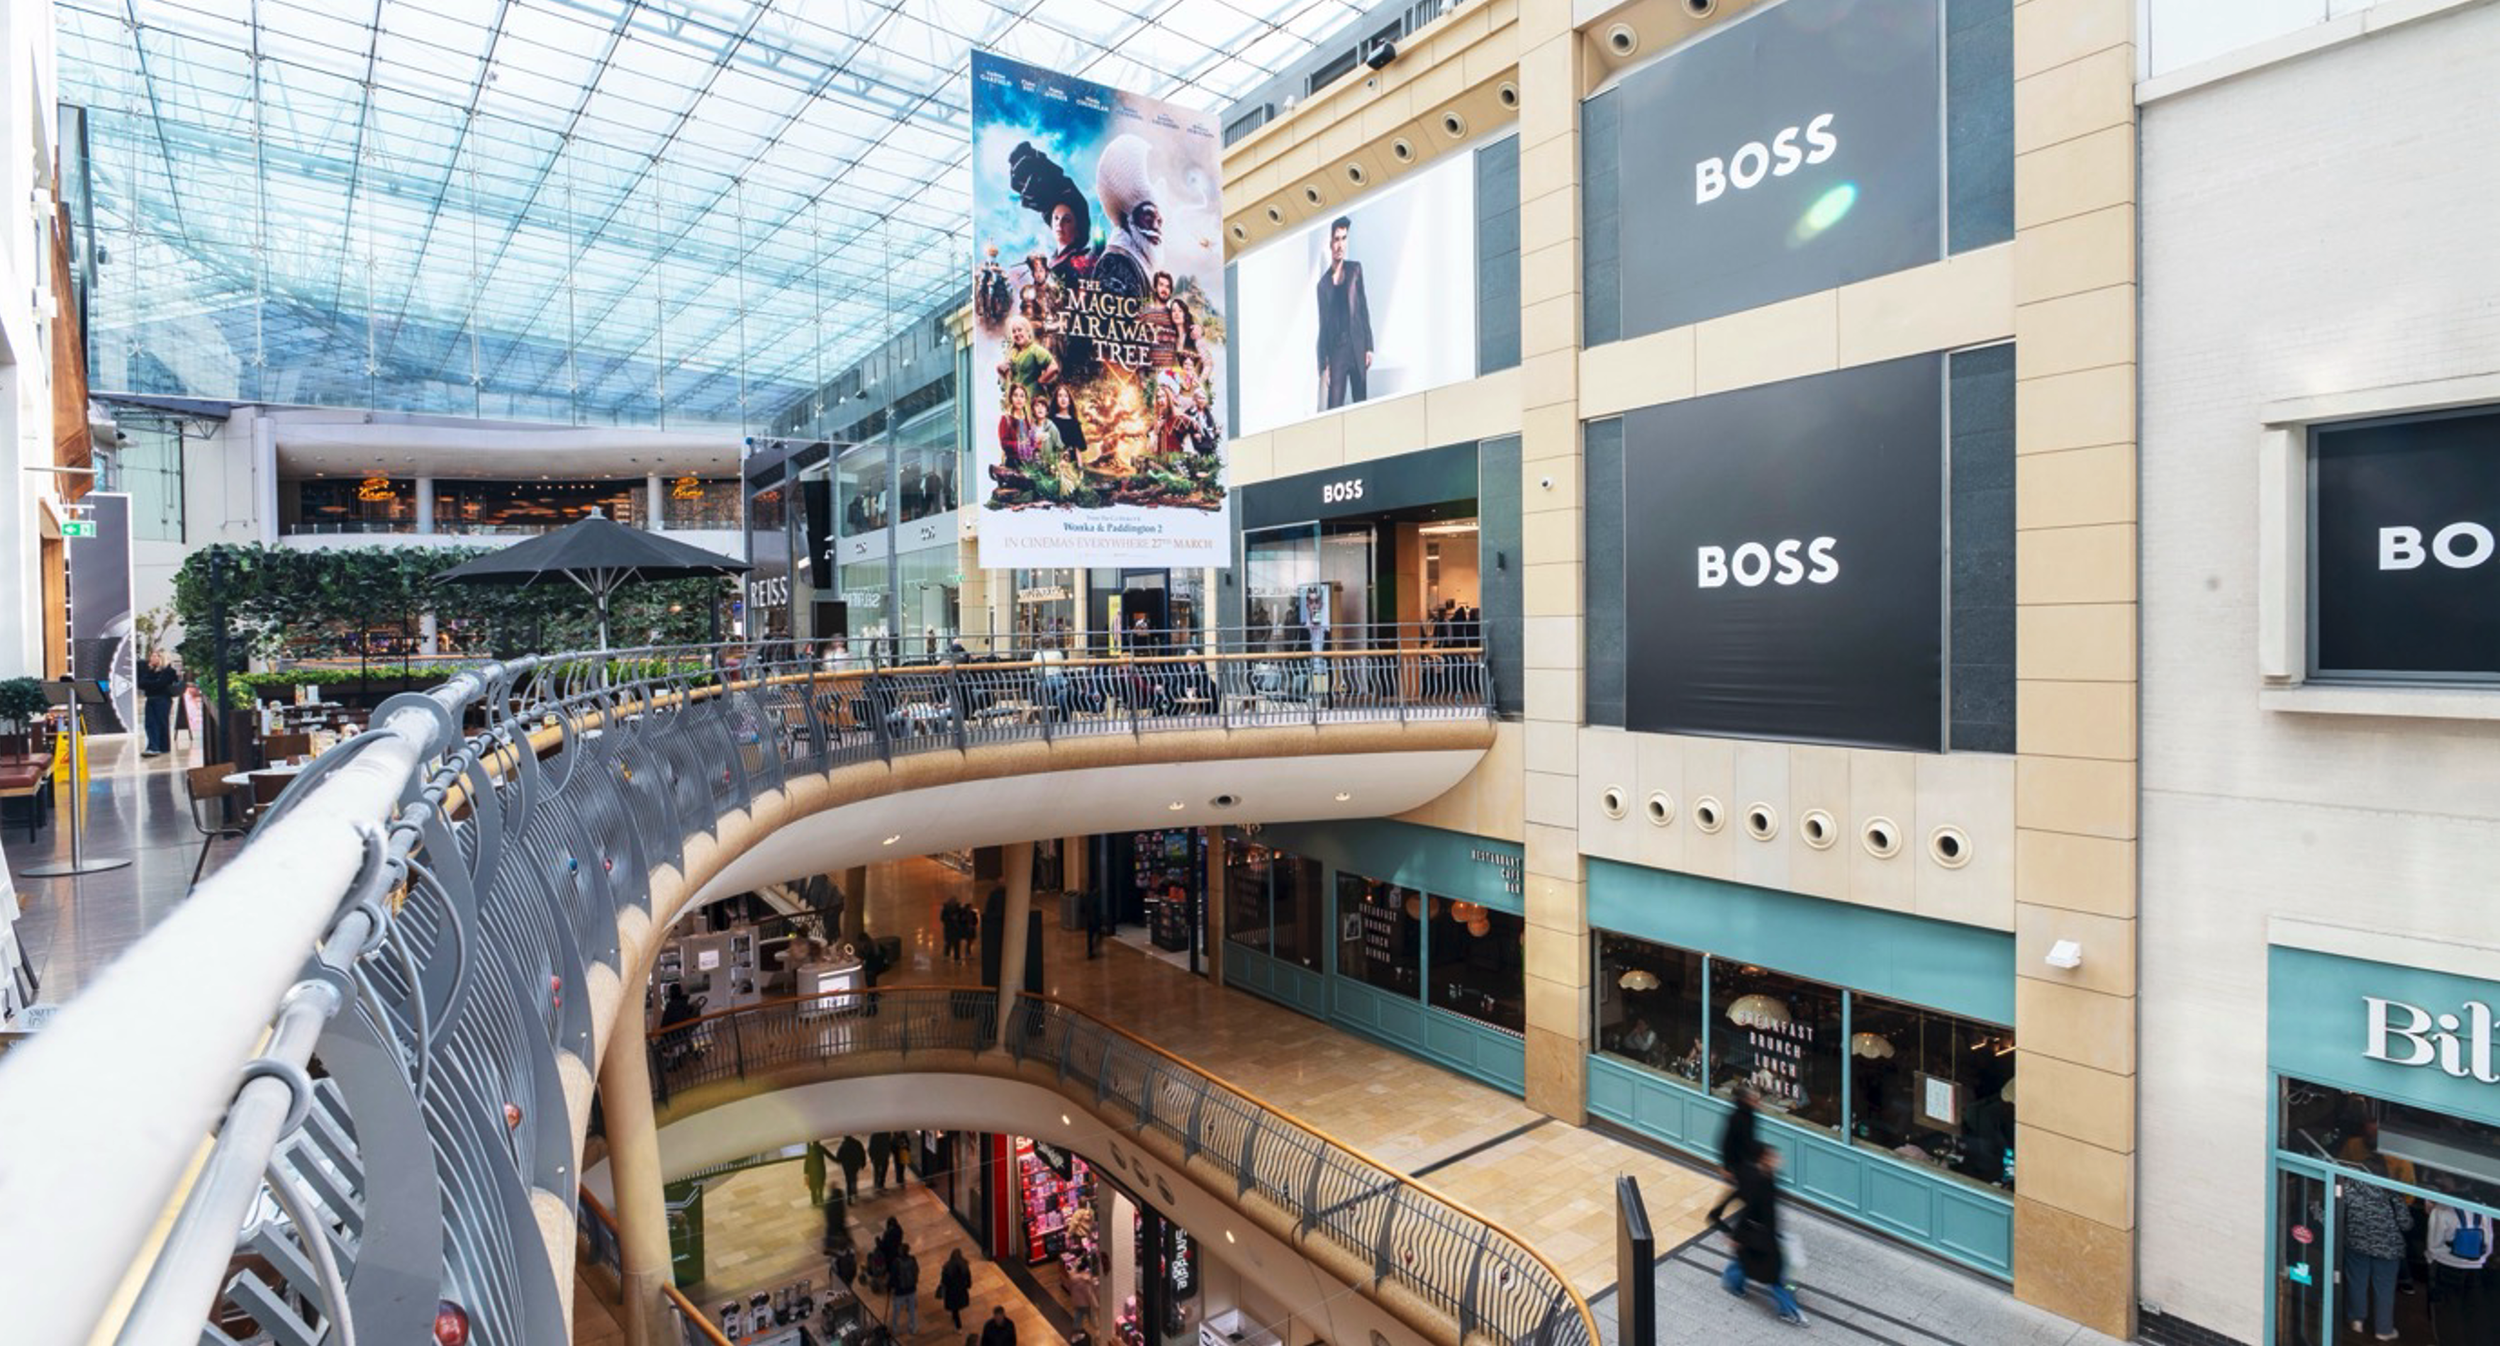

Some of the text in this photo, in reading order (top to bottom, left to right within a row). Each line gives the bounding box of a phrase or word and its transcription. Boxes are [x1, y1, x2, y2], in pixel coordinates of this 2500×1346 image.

[1695, 113, 1839, 205] BOSS
[1078, 279, 1102, 291] THE
[1065, 288, 1138, 320] MAGIC
[1057, 311, 1160, 344] FARAWAY
[1092, 340, 1153, 372] TREE
[1323, 480, 1364, 504] BOSS
[1005, 537, 1018, 548] IN
[1021, 537, 1074, 549] CINEMAS
[1077, 537, 1149, 549] EVERYWHERE
[1173, 538, 1213, 549] MARCH
[1063, 522, 1163, 535] Wonka & Paddington 2
[2379, 521, 2496, 571] BO
[1697, 536, 1840, 589] BOSS
[750, 576, 788, 608] REISS
[1739, 1010, 1813, 1042] BREAKFAST
[1750, 1031, 1801, 1059] BRUNCH
[1754, 1052, 1797, 1077] LUNCH
[1751, 1071, 1799, 1099] DINNER
